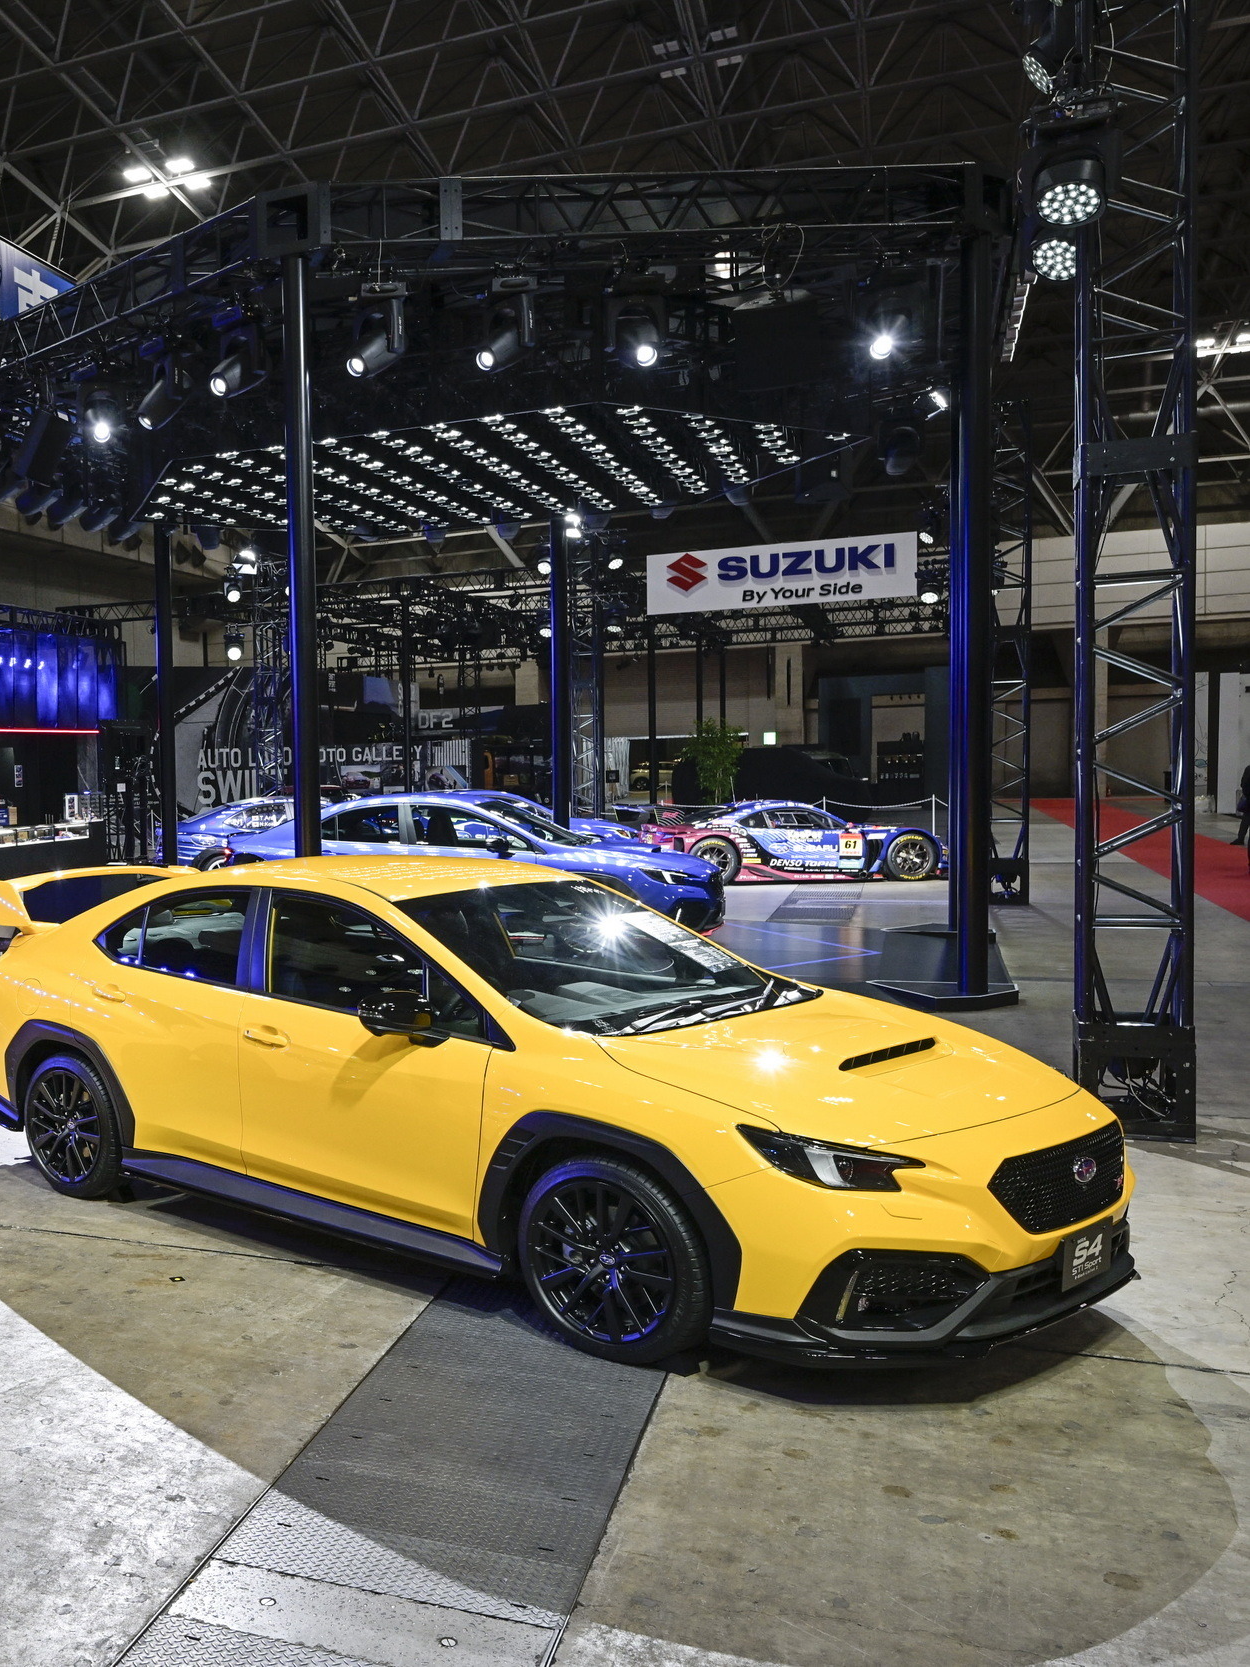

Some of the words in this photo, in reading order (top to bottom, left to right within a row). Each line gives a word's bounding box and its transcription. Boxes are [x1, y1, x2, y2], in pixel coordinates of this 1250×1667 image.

[717, 543, 895, 581] SUZUKI
[742, 589, 767, 604] By
[770, 586, 815, 601] Your
[819, 581, 863, 597] Side
[197, 747, 241, 768] AUTO
[352, 745, 422, 762] GALLEY
[792, 844, 838, 852] SUBARU
[844, 840, 857, 849] 61
[770, 859, 802, 867] DENSO
[1072, 1233, 1103, 1267] S4
[1072, 1264, 1083, 1276] STI
[1084, 1256, 1102, 1270] Sport
